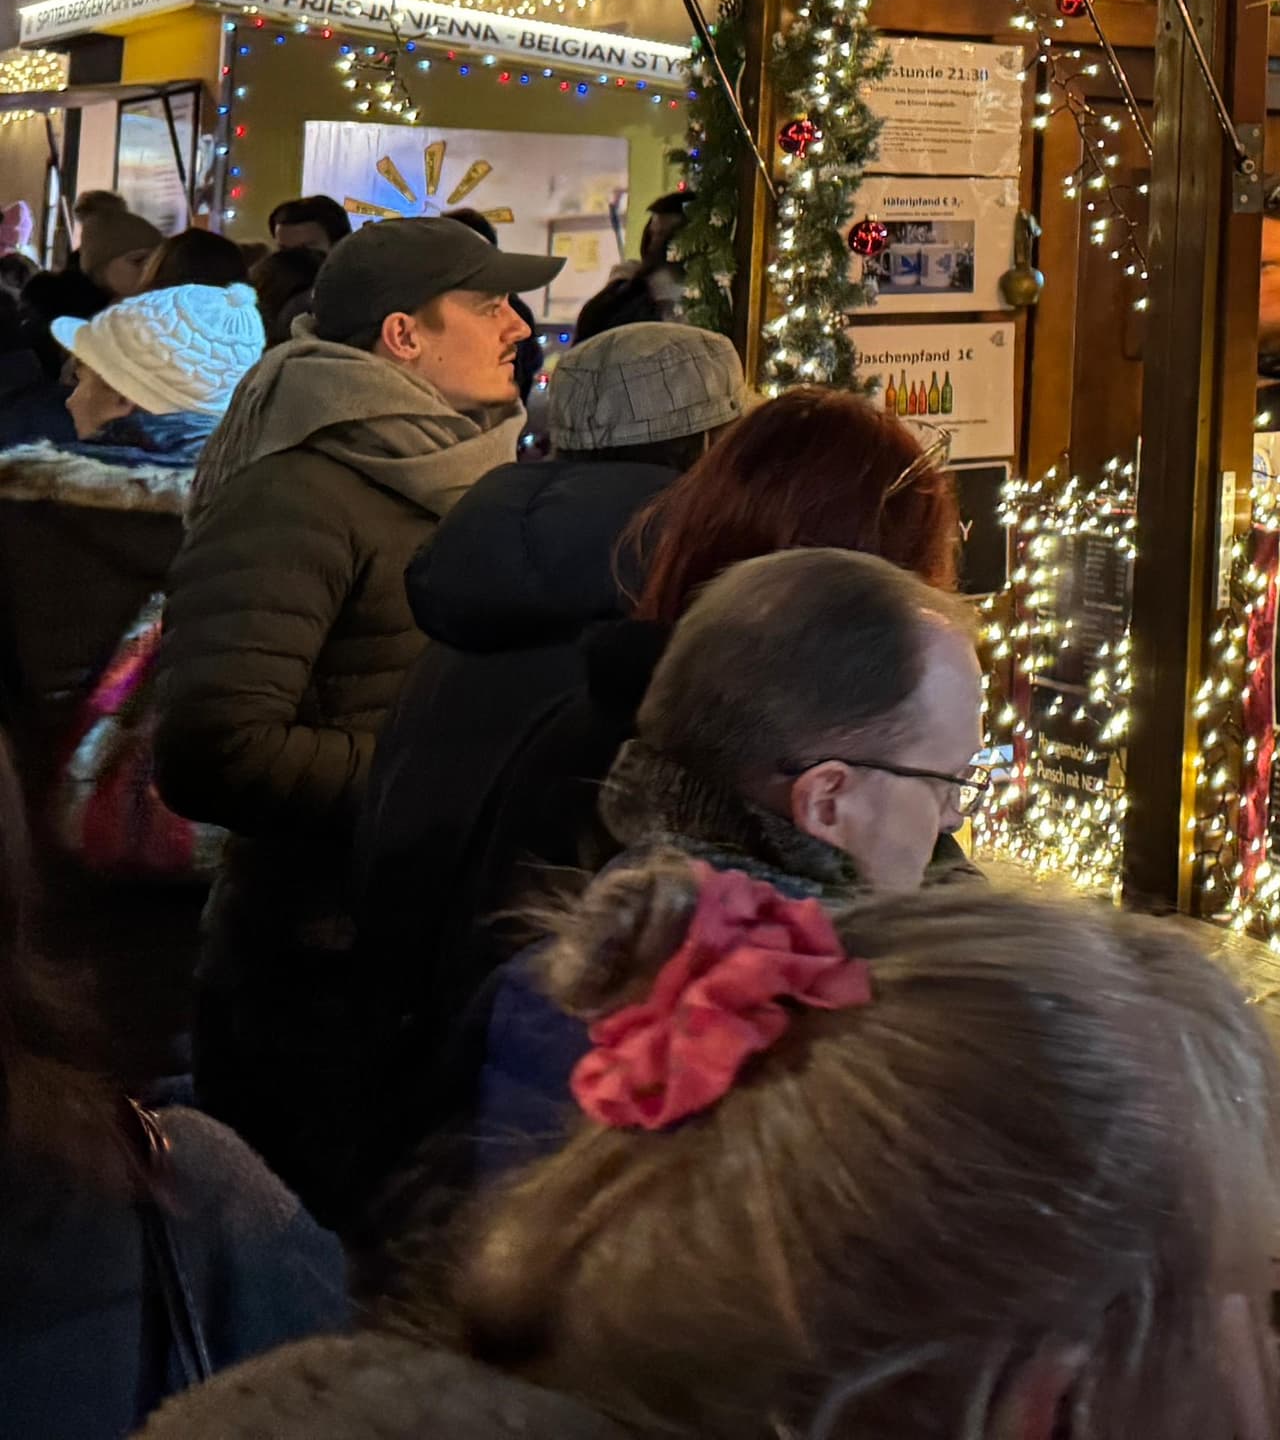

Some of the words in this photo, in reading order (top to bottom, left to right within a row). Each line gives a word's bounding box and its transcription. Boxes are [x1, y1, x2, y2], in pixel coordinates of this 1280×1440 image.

[405, 6, 499, 44] VIENNA
[519, 30, 625, 66] BELGIAN
[631, 50, 685, 74] STY
[891, 65, 944, 79] stunde
[858, 349, 950, 366] laschenpfand
[1036, 759, 1066, 785] Punsch
[1066, 770, 1080, 790] mit
